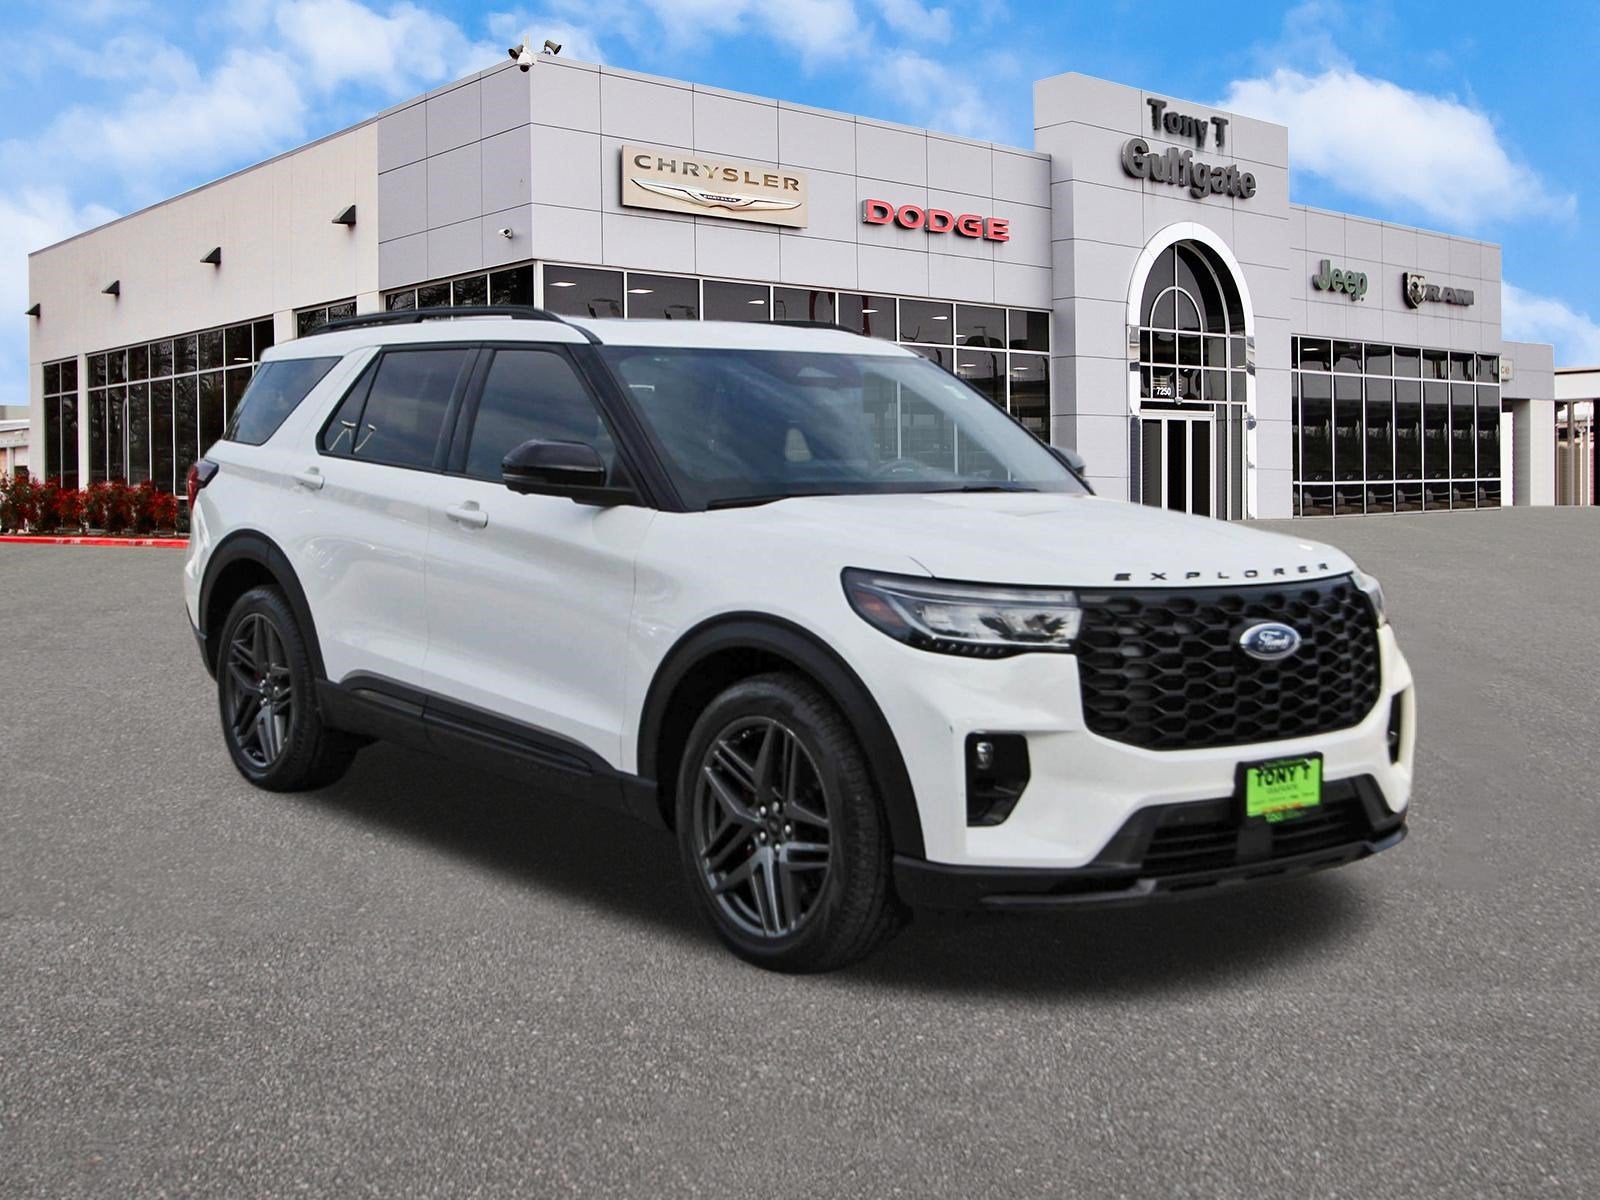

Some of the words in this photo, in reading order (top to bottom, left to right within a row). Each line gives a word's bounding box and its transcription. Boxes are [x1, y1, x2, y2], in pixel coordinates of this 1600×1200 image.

[1146, 98, 1208, 148] Tony
[1210, 116, 1229, 148] T
[634, 154, 800, 192] CHRYSLER
[1122, 138, 1257, 199] Gulfgate
[862, 198, 1011, 242] DODGE
[1312, 259, 1368, 301] Jeep
[1425, 283, 1475, 306] RAM
[1156, 387, 1171, 396] 7250
[1113, 562, 1329, 582] EXPLORER
[1259, 630, 1291, 650] Ford
[1256, 765, 1297, 787] TONY
